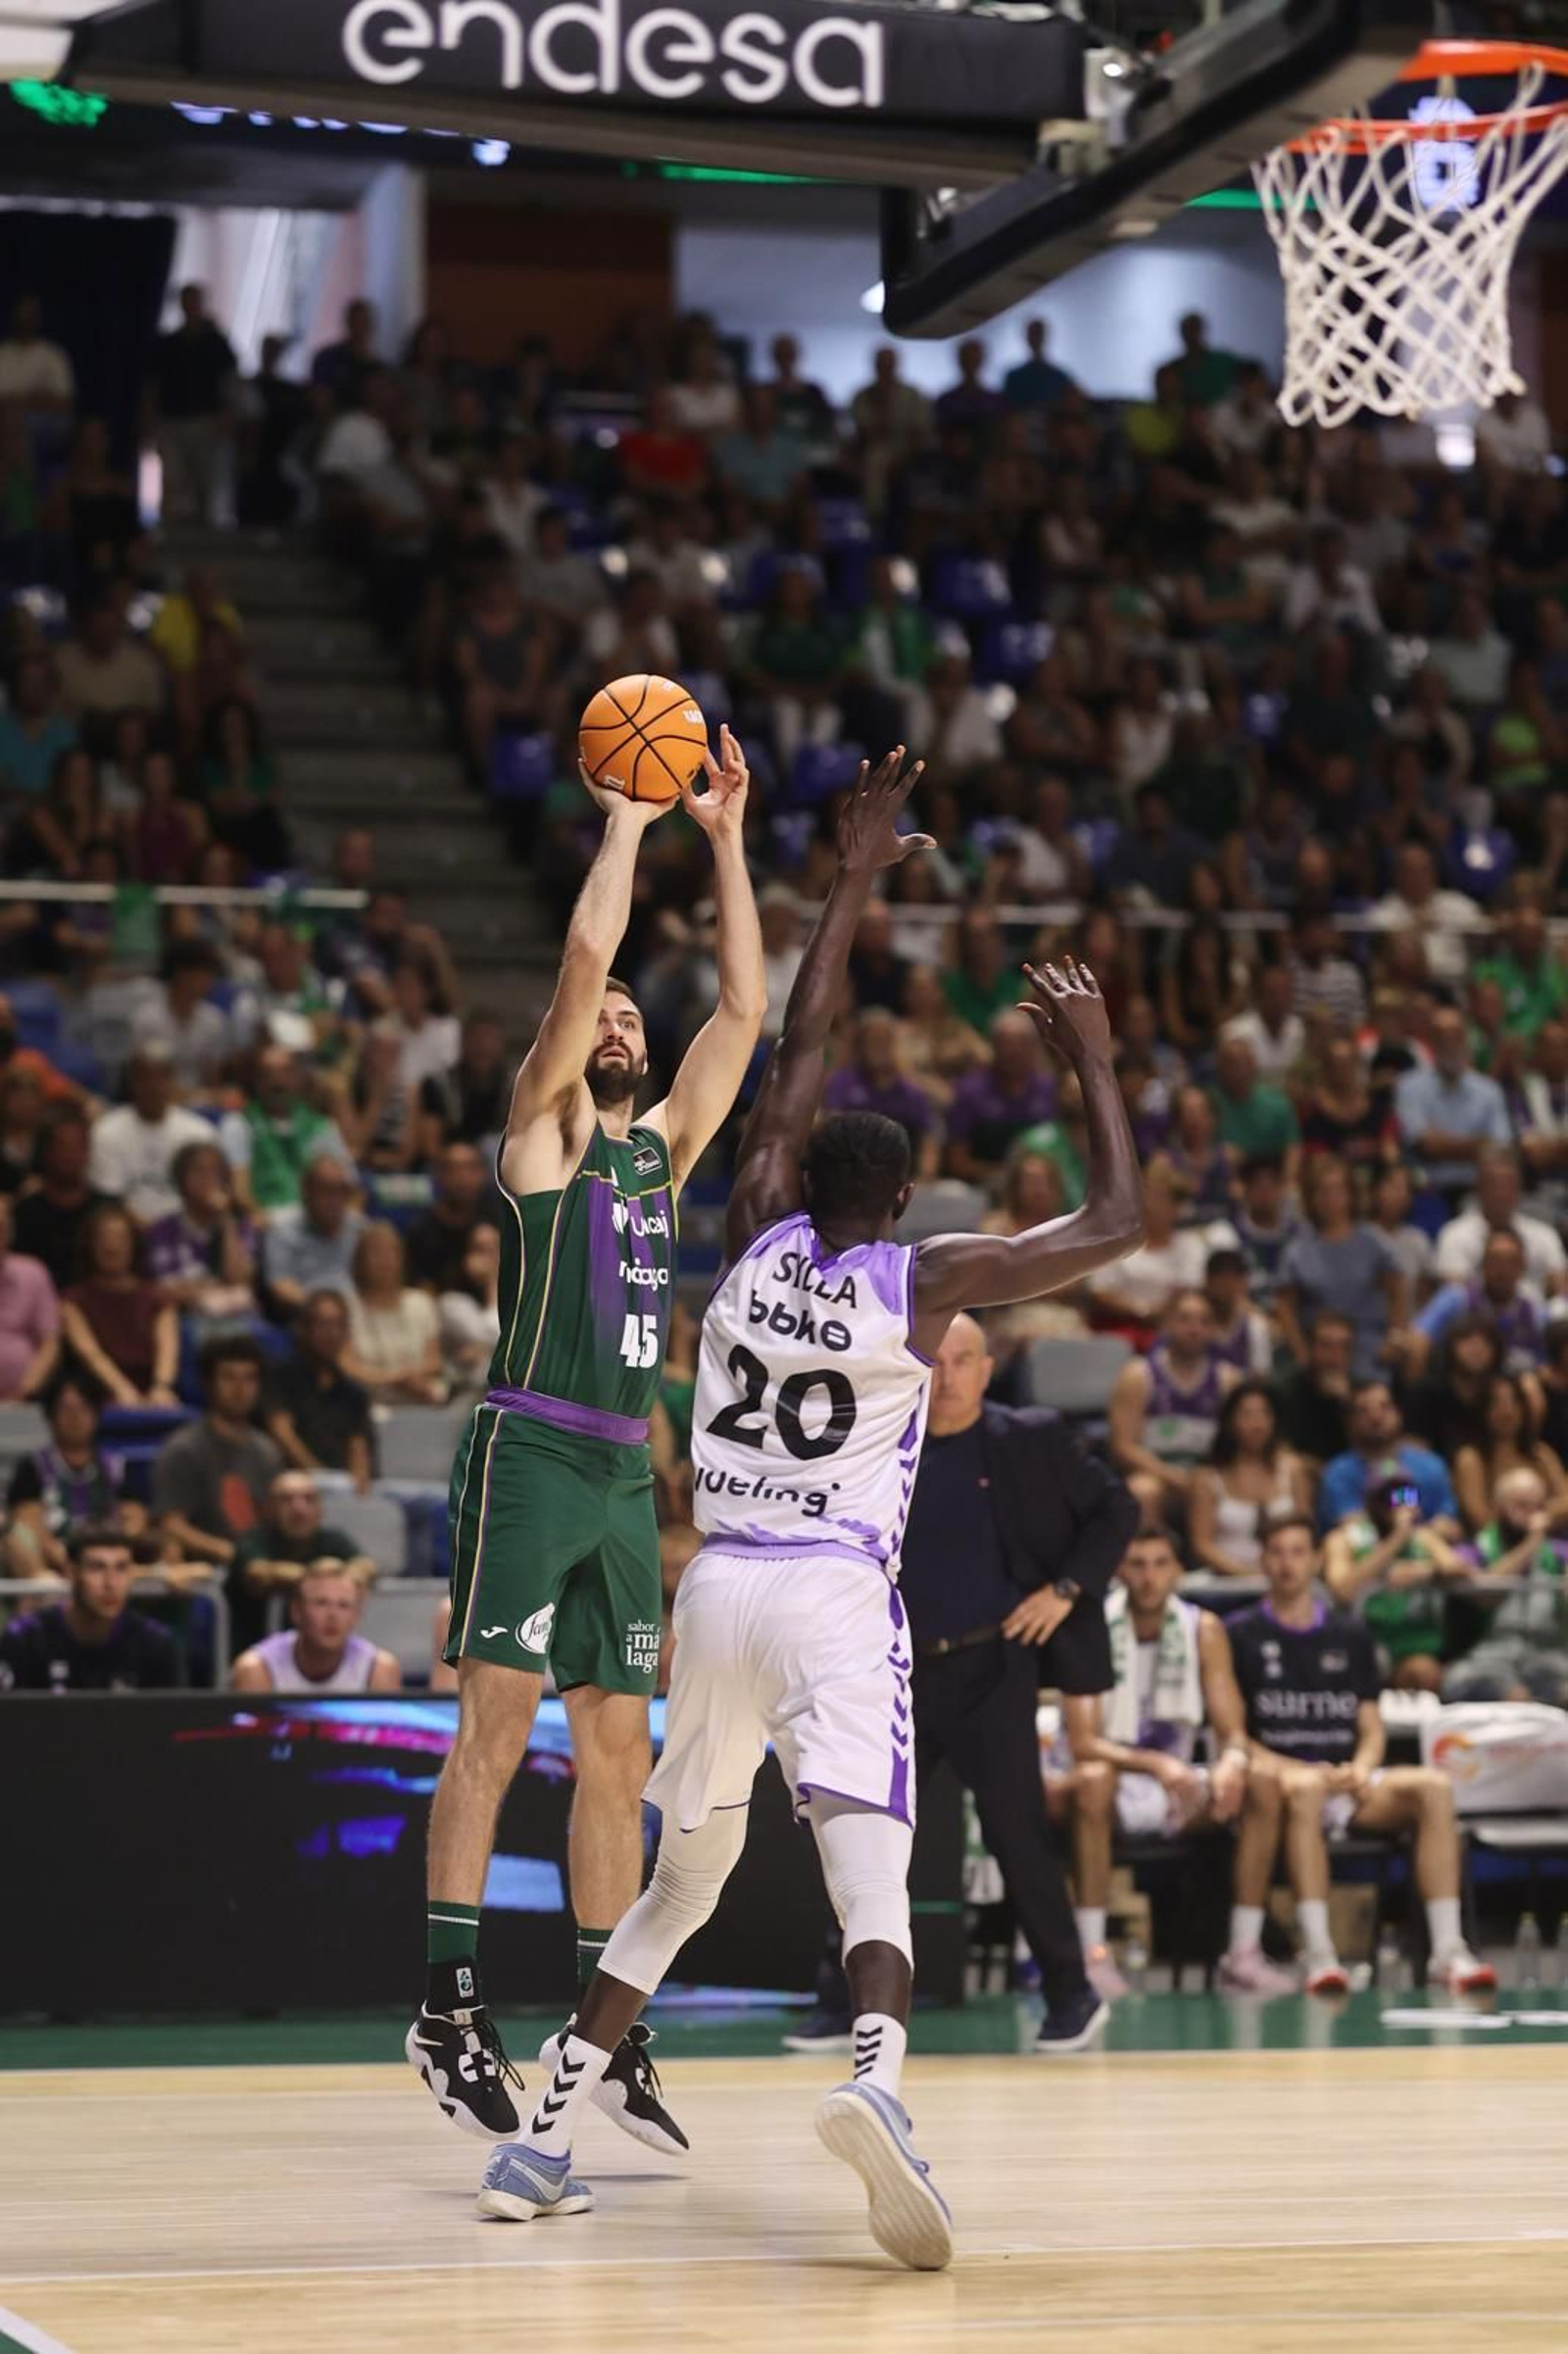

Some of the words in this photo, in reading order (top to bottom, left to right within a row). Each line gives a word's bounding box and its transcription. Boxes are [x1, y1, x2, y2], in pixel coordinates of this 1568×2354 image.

[342, 0, 884, 108] endesa
[619, 1313, 659, 1368] 45
[706, 1344, 858, 1461] 20
[627, 1618, 656, 1633] sabor
